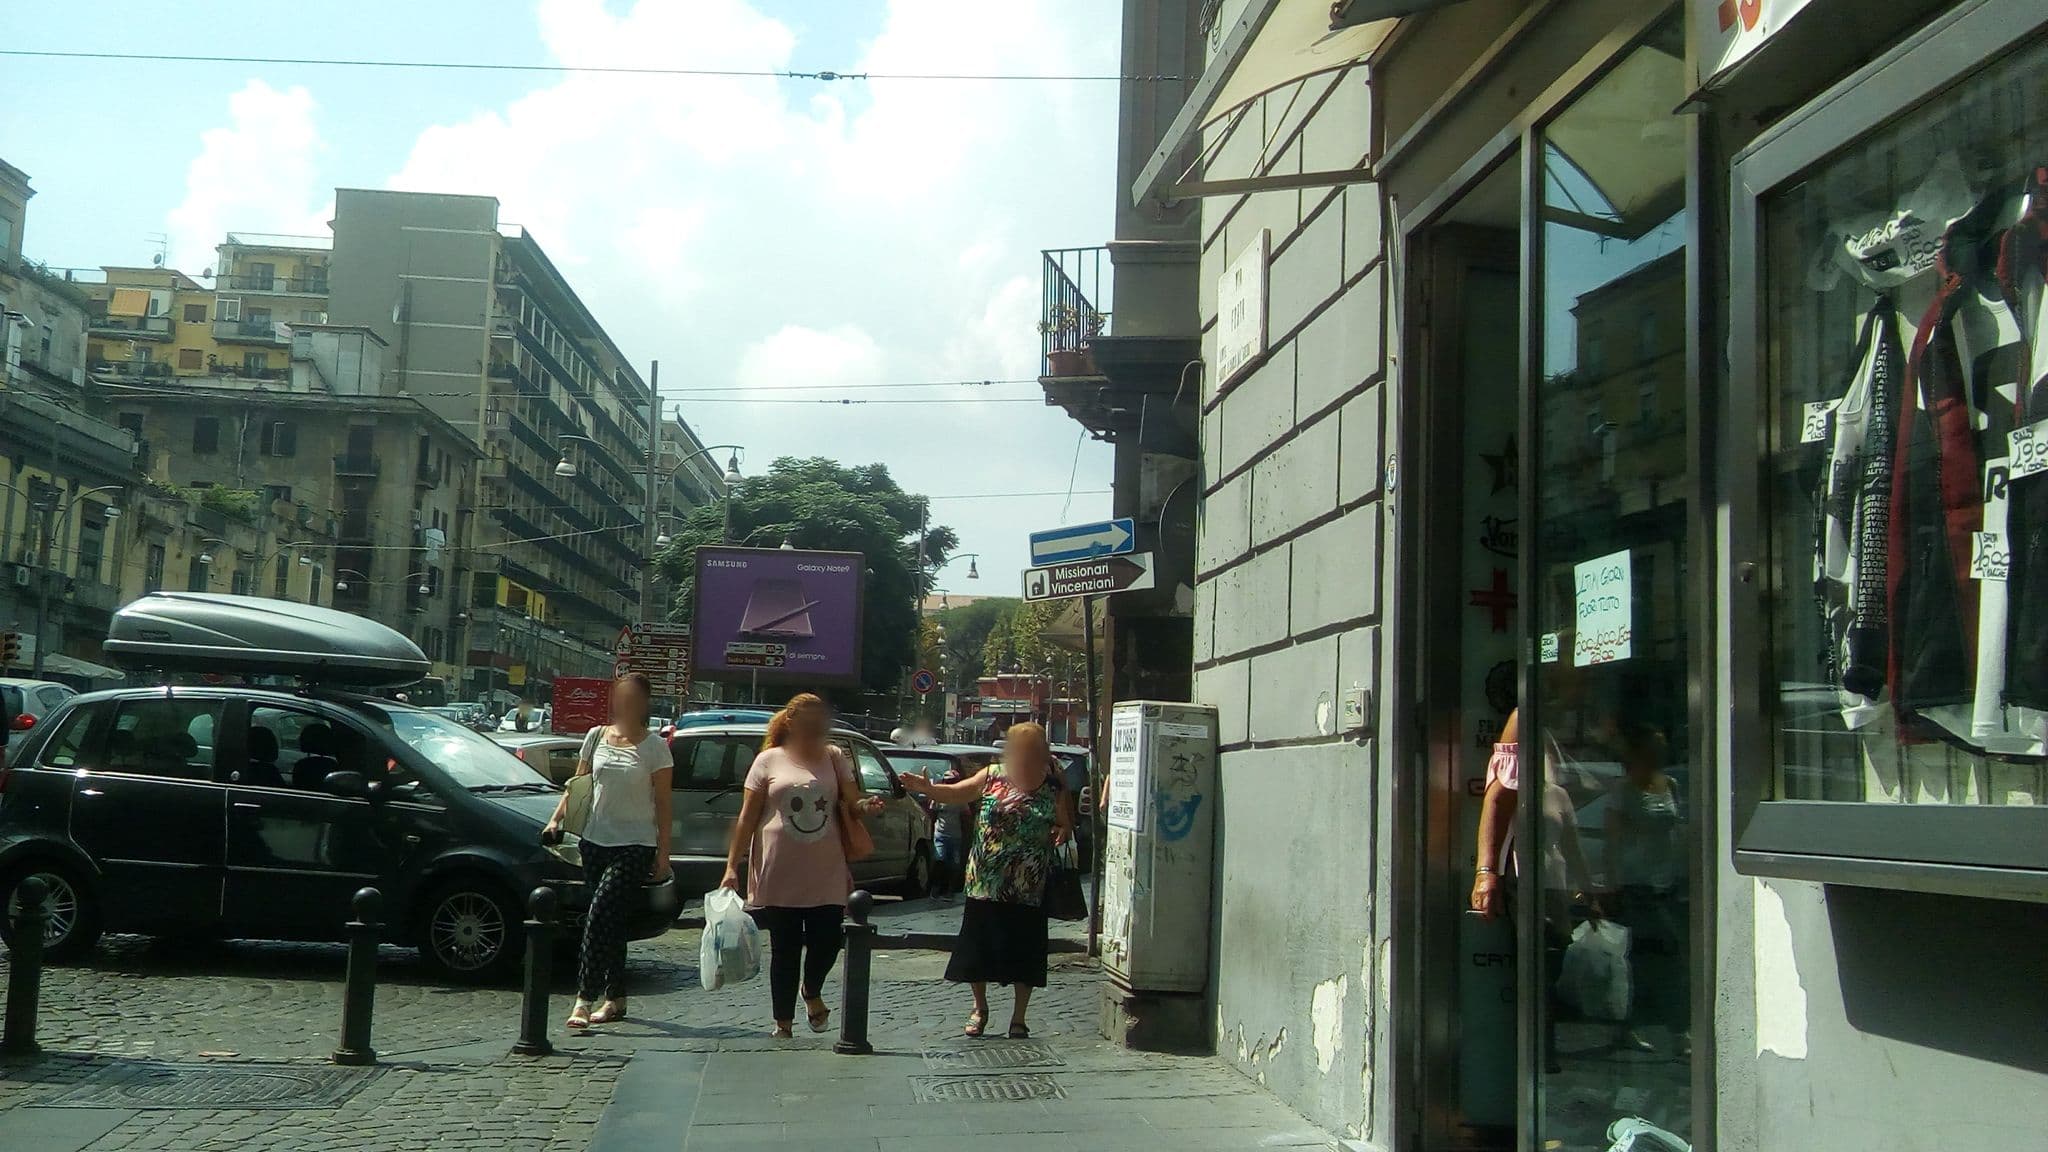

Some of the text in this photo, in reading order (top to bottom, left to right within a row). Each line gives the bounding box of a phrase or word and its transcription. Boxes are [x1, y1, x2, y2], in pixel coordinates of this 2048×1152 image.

[706, 559, 748, 569] SAMSUNG
[797, 563, 850, 574] Galaxy Note9
[1055, 562, 1109, 580] Missionari
[1051, 576, 1115, 594] Vincenziani
